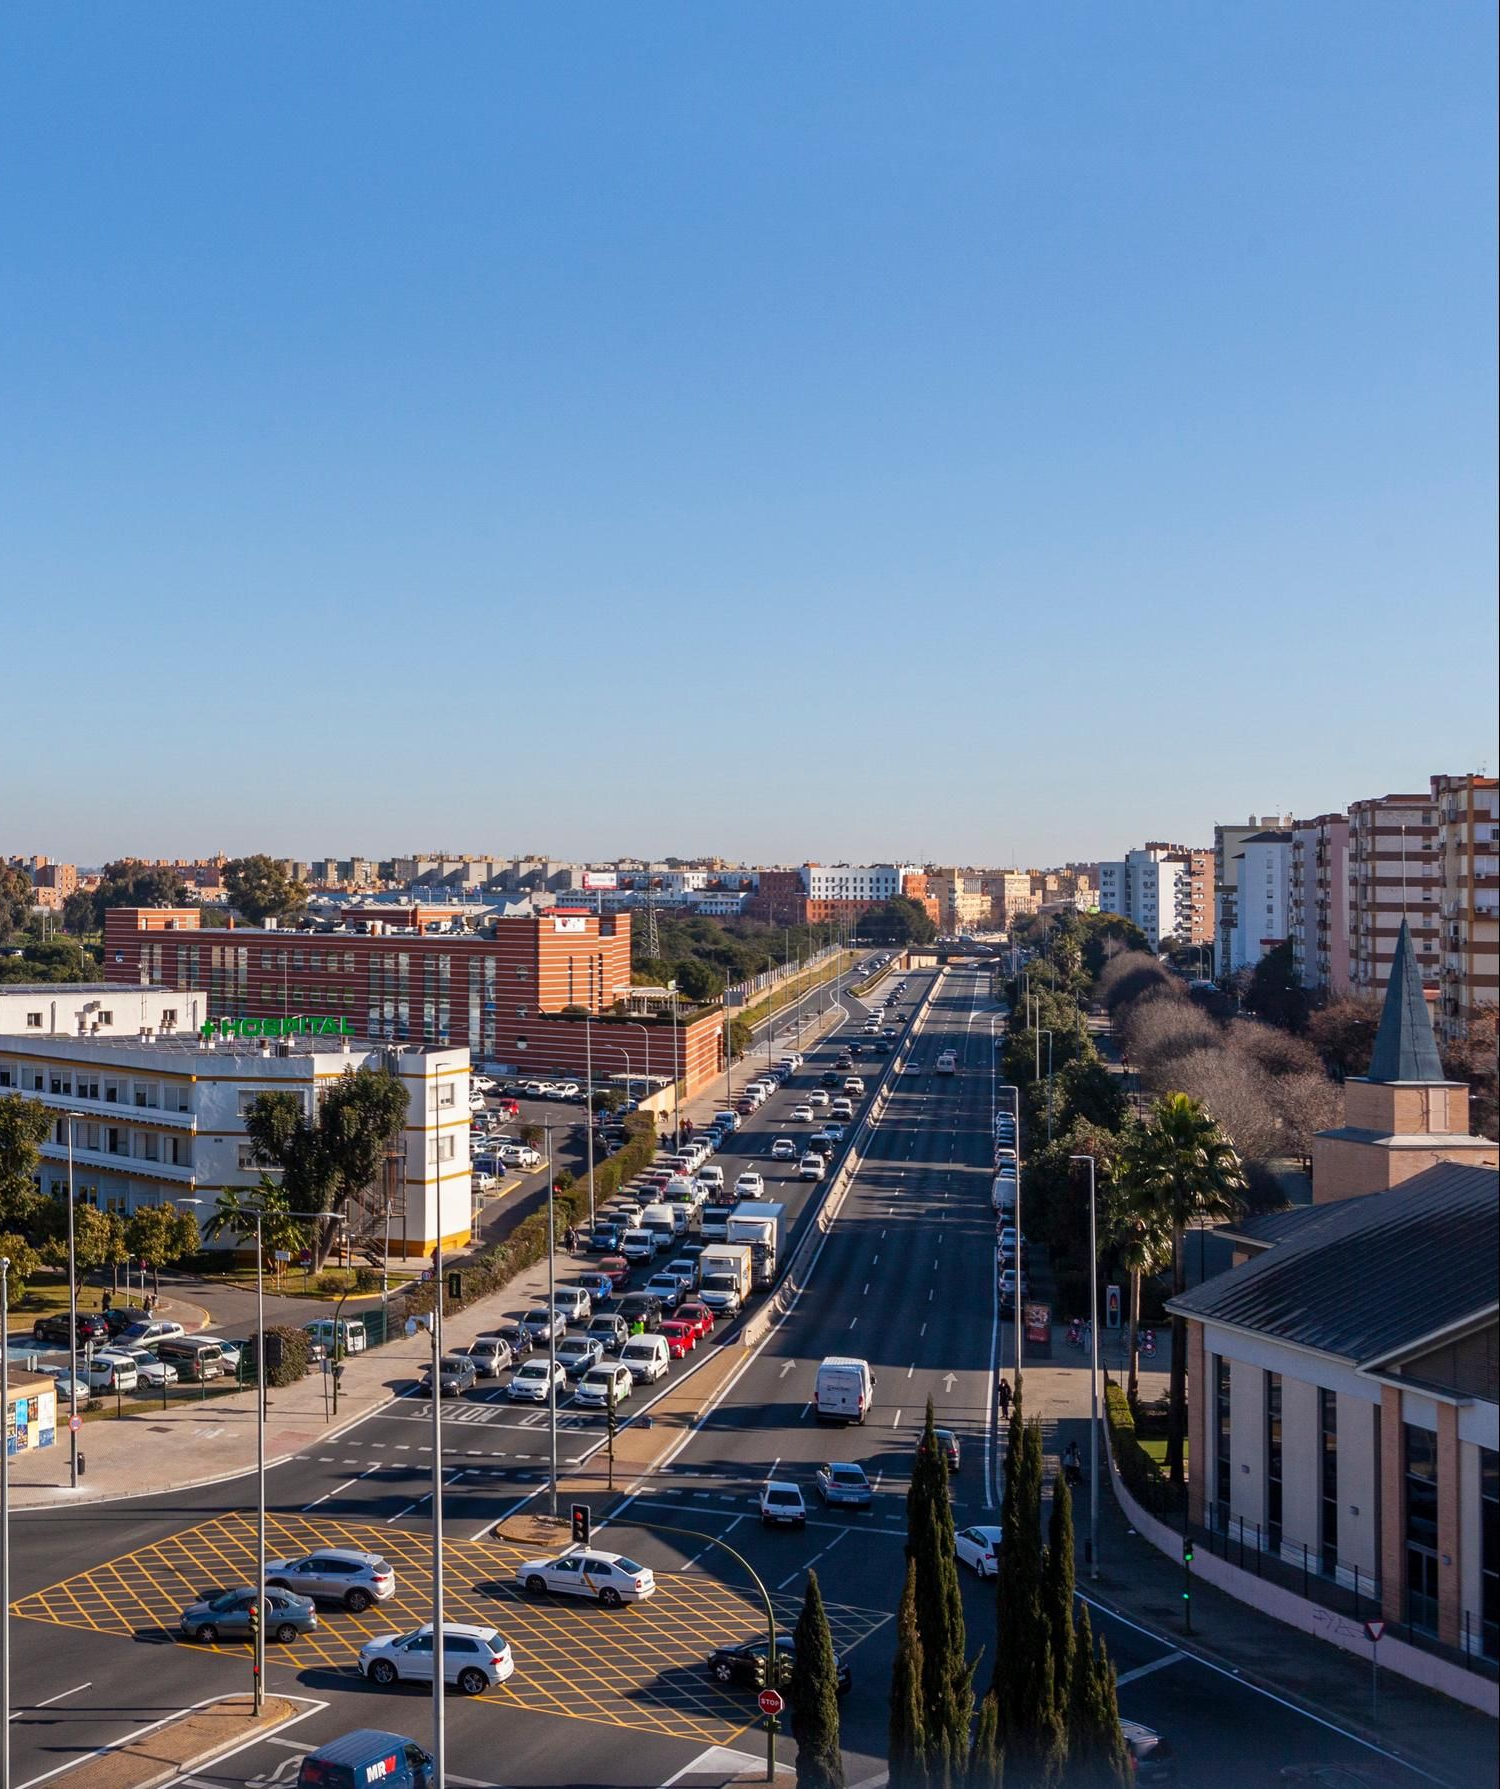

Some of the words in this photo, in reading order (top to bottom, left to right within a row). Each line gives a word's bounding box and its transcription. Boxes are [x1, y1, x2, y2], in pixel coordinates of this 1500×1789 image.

[221, 1016, 356, 1037] HOSPITAL
[760, 1698, 780, 1707] STOP
[366, 1754, 397, 1783] MRW
